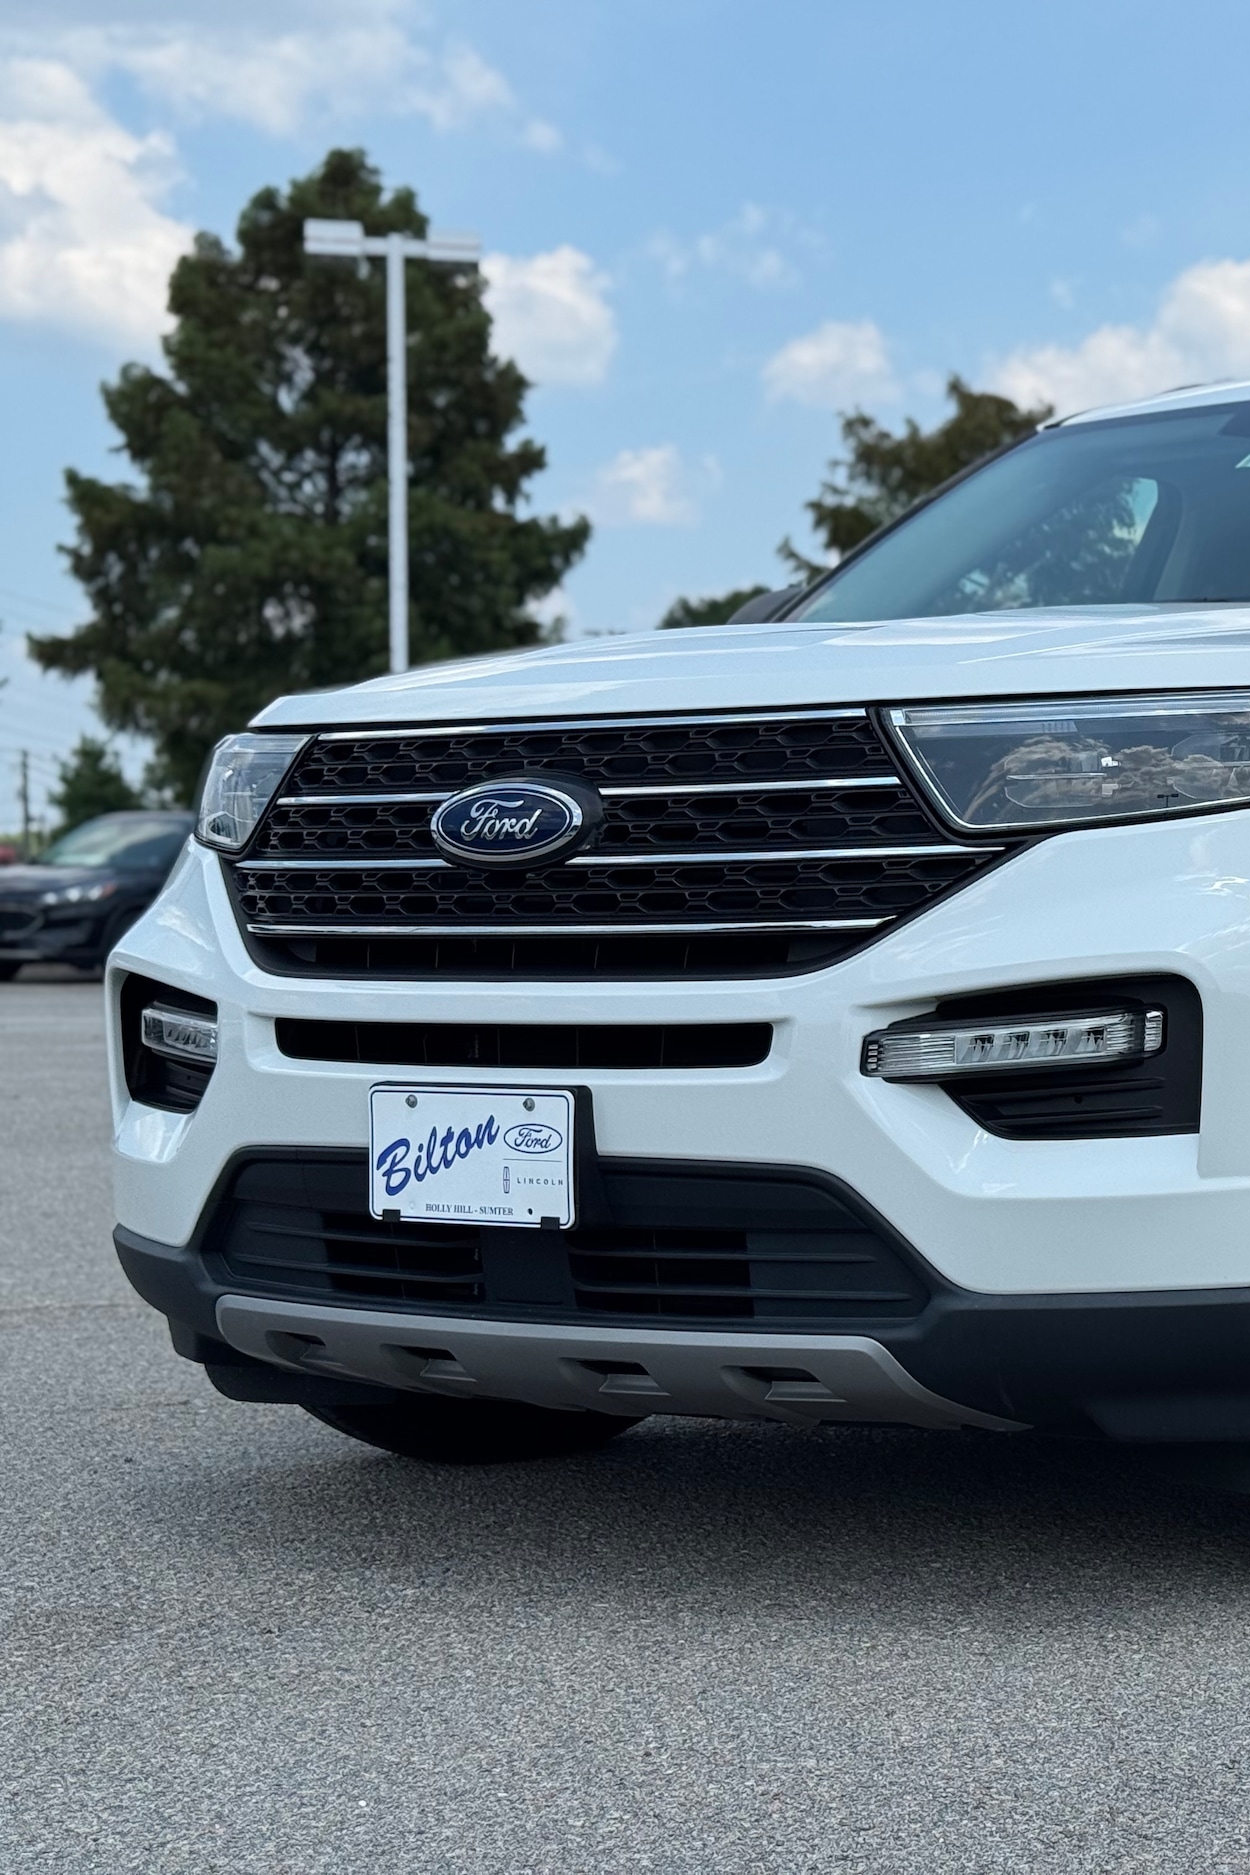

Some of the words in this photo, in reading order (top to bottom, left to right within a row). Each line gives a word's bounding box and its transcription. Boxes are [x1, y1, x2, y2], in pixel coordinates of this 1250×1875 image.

[460, 798, 543, 842] Ford
[514, 1127, 552, 1150] Ford
[376, 1114, 501, 1196] Bilton
[516, 1177, 564, 1186] LINCOLN
[425, 1203, 453, 1213] HOLLY
[453, 1204, 474, 1214] HILL
[479, 1206, 514, 1216] SUMTER
